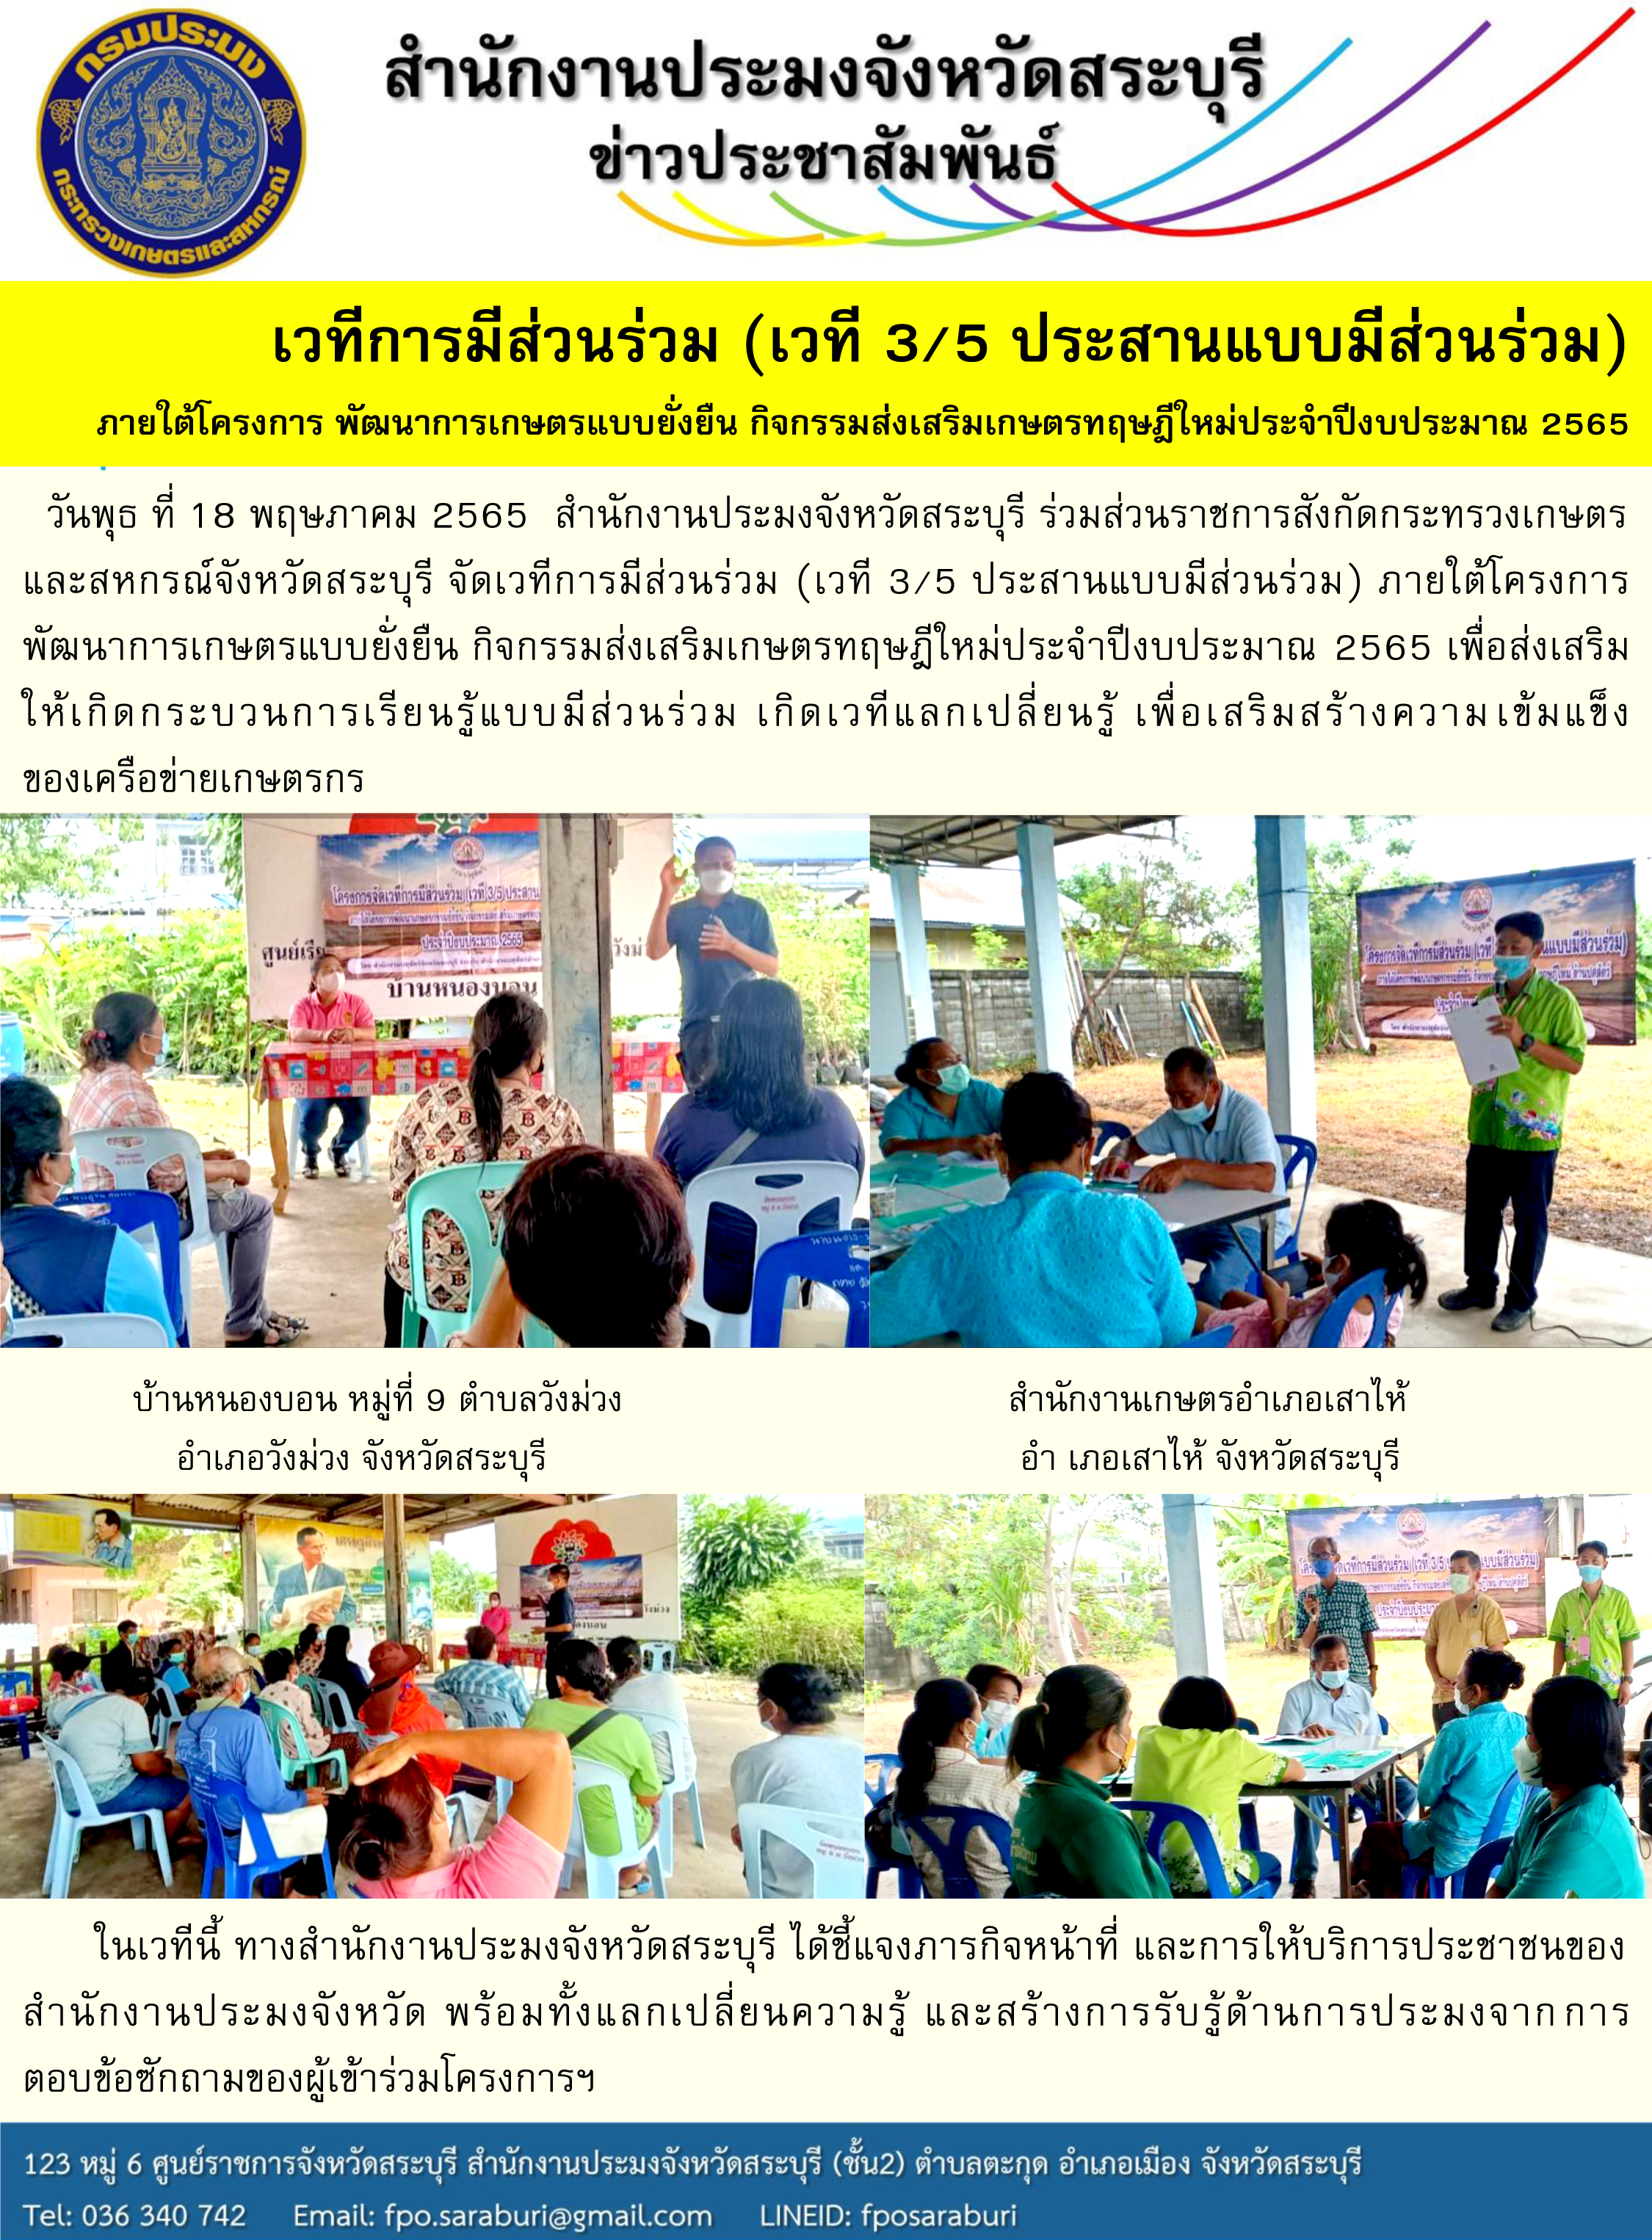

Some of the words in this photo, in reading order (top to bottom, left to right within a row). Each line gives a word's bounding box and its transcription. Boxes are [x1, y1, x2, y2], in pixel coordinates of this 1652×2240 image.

[505, 885, 540, 900] ประสาน
[501, 932, 523, 947] 2565
[612, 936, 647, 957] วังม่
[1542, 927, 1627, 955] นแบบมีส่วนร่วม)
[262, 938, 325, 968] ศูนย์เรีย
